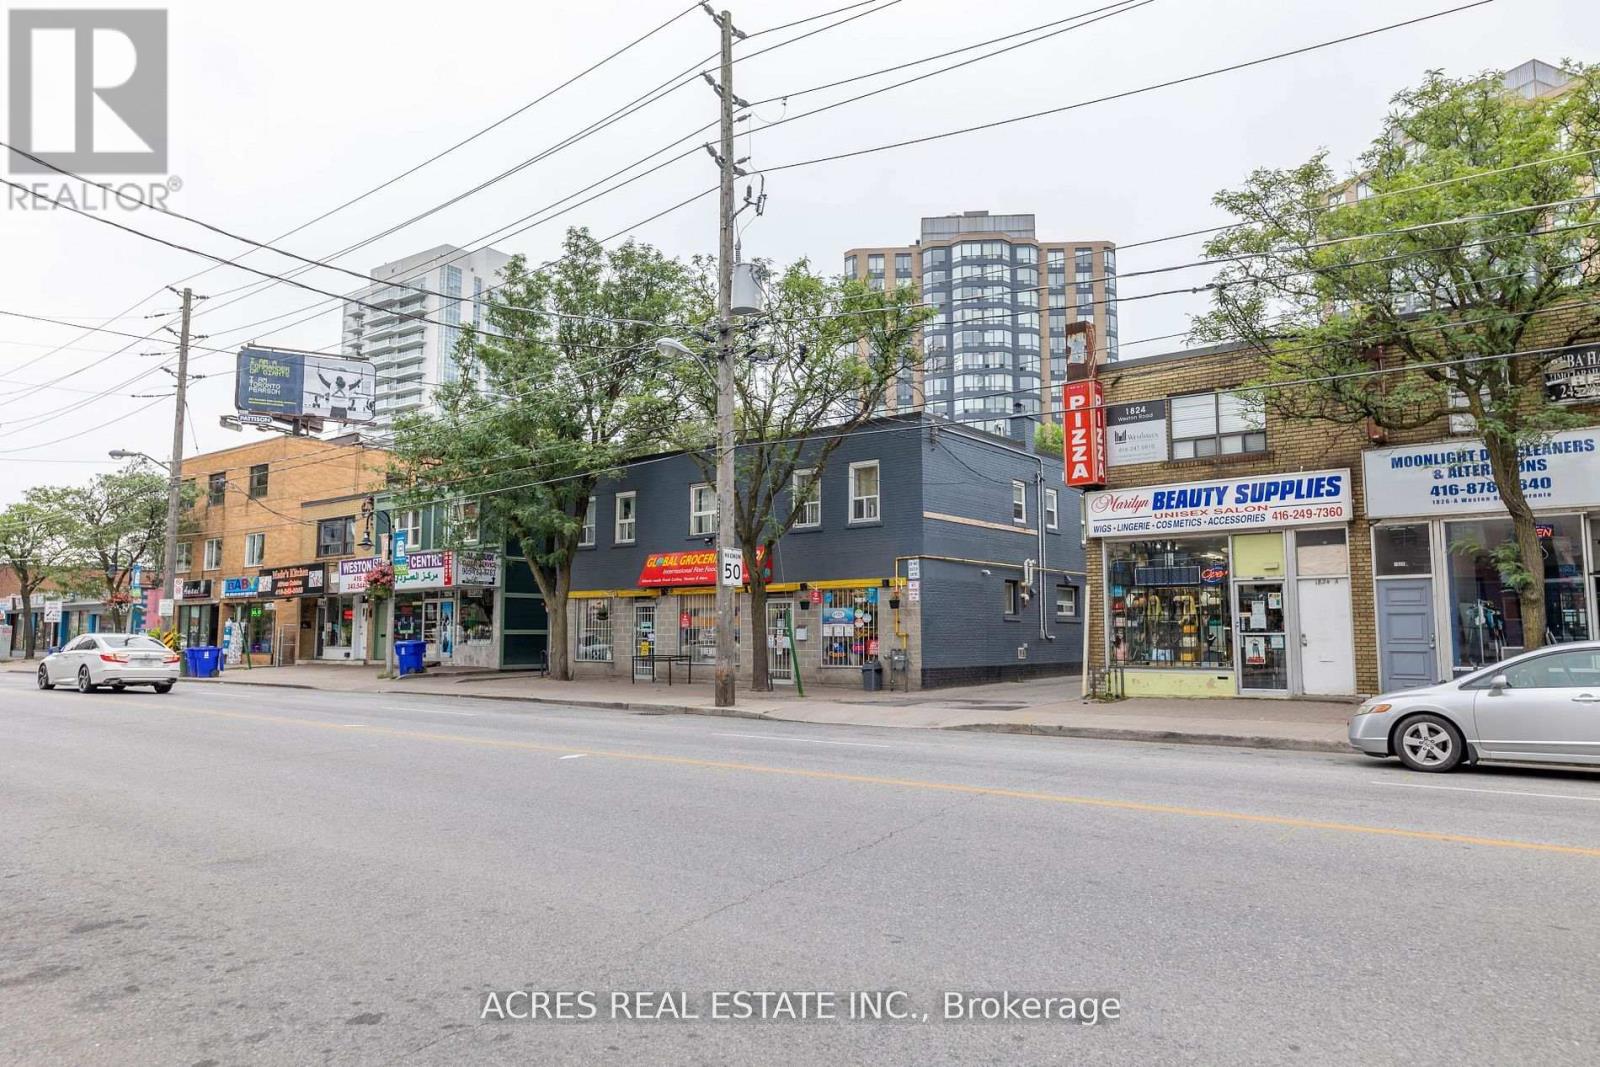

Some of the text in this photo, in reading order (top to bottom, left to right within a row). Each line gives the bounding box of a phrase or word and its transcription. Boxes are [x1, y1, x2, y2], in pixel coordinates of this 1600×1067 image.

[248, 387, 280, 395] PEARSON
[250, 381, 280, 389] TORONTO
[1125, 405, 1146, 415] 1824
[1070, 395, 1089, 479] PIZZA
[1095, 394, 1105, 478] PIZZA
[1391, 449, 1475, 469] MOONLIGHT
[1433, 469, 1443, 480] &
[1091, 475, 1342, 514] Marilyn BEAUTY SUPPLIES
[1461, 495, 1490, 503] Weston
[1154, 504, 1268, 519] UNISEX SALON
[1271, 506, 1343, 521] 416-249-7360
[1093, 513, 1266, 533] WIGS LINGERIE COSMETICS ACCESSORIES
[1536, 528, 1552, 538] EN
[343, 560, 372, 573] WESTON
[411, 553, 442, 568] CENTRE
[724, 563, 741, 580] 50
